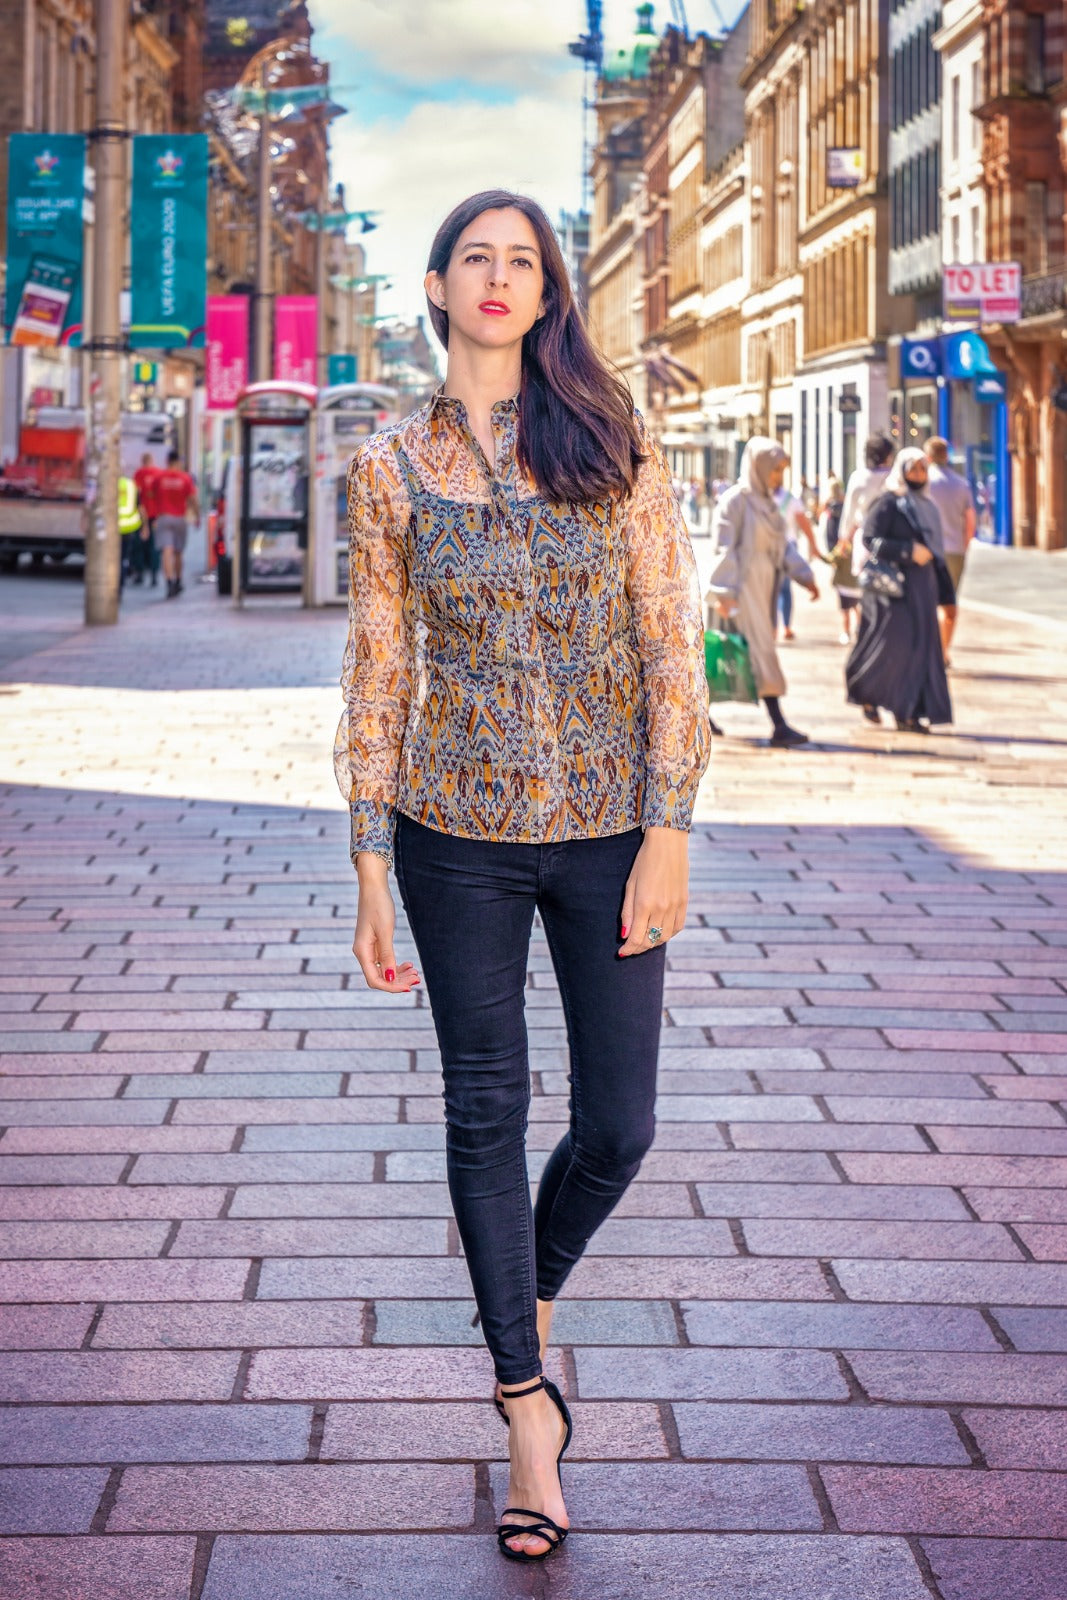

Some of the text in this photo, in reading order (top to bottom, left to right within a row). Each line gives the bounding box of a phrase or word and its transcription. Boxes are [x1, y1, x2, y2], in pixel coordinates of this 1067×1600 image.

[162, 198, 175, 234] 2020
[162, 236, 175, 276] EURO
[162, 278, 175, 316] UEFA
[944, 268, 1019, 294] TO LET
